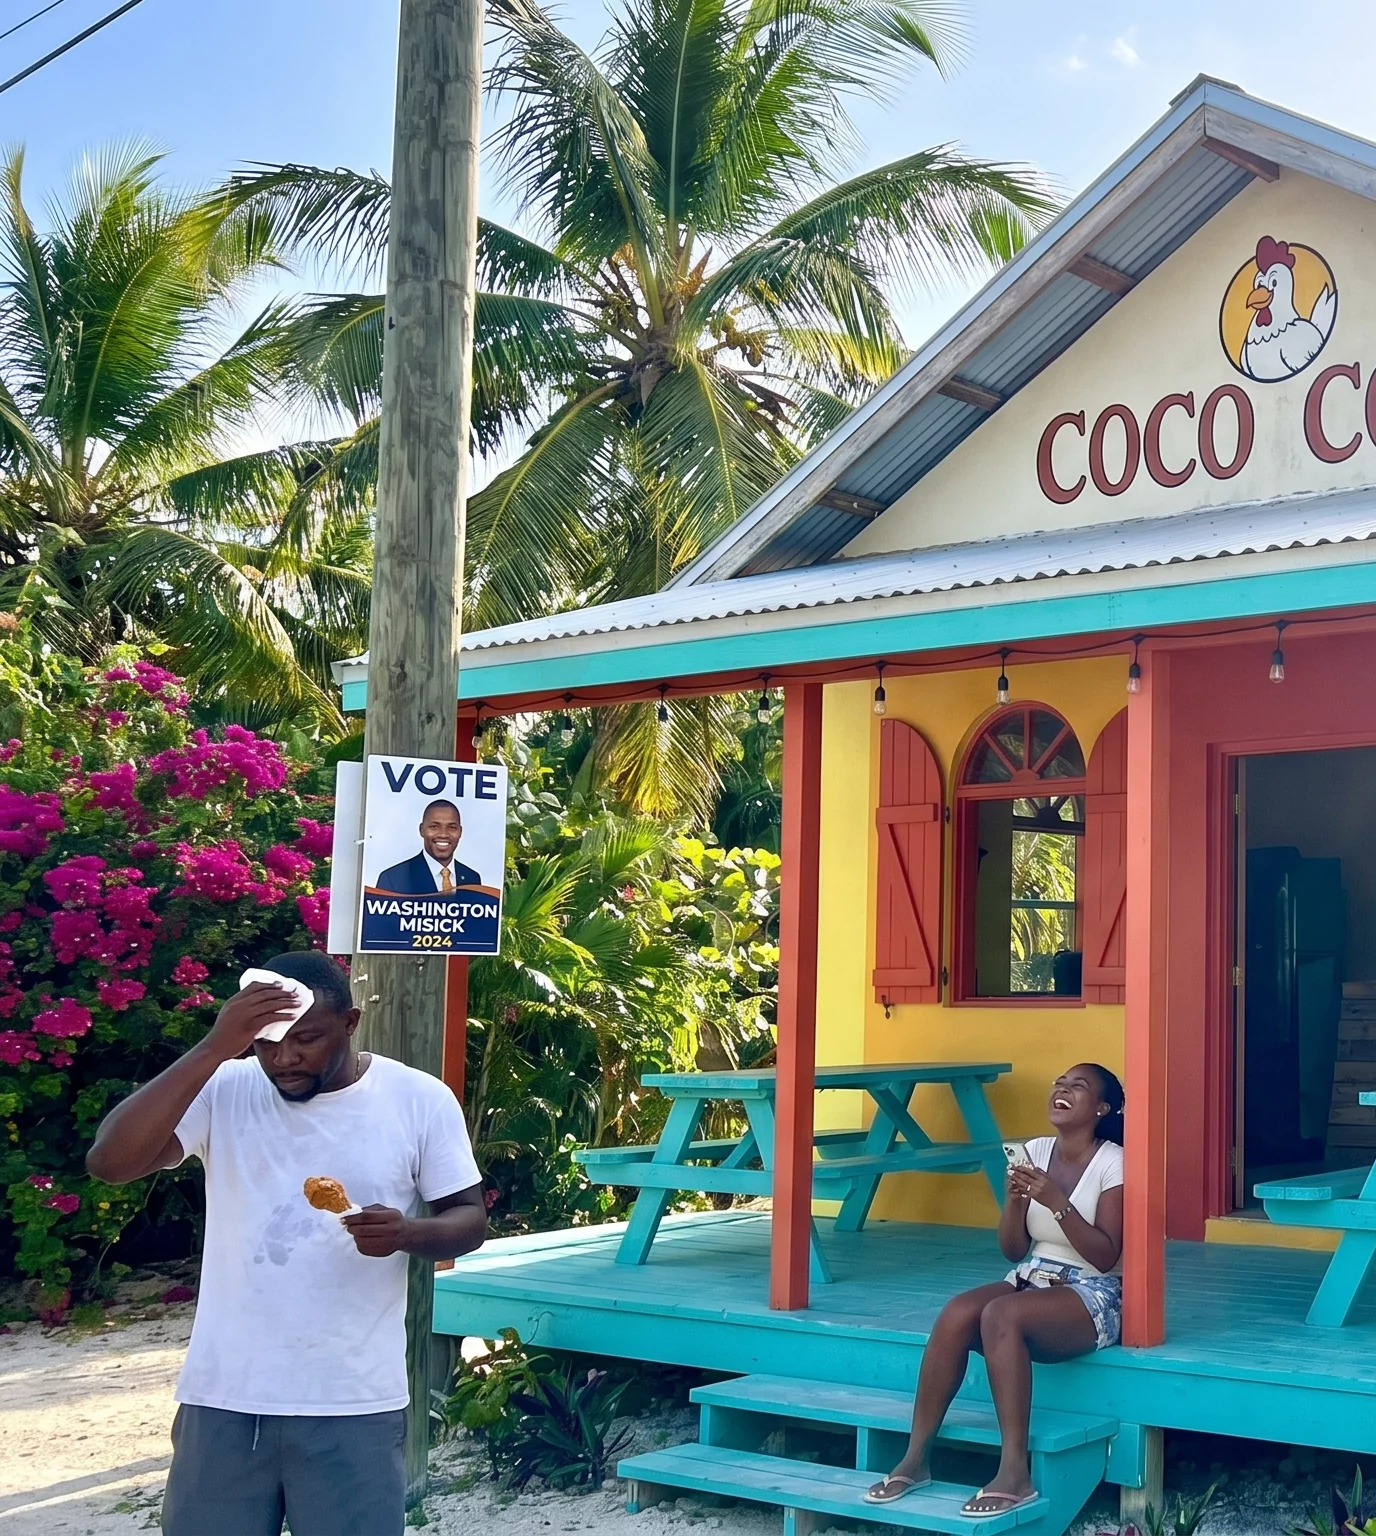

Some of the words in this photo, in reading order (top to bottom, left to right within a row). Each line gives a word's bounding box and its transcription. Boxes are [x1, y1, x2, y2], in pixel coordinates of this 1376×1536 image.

[1036, 383, 1255, 504] COCO
[381, 761, 498, 800] VOTE
[366, 900, 498, 919] WASHINGTON
[399, 917, 465, 933] MISICK
[412, 935, 453, 948] 2024
